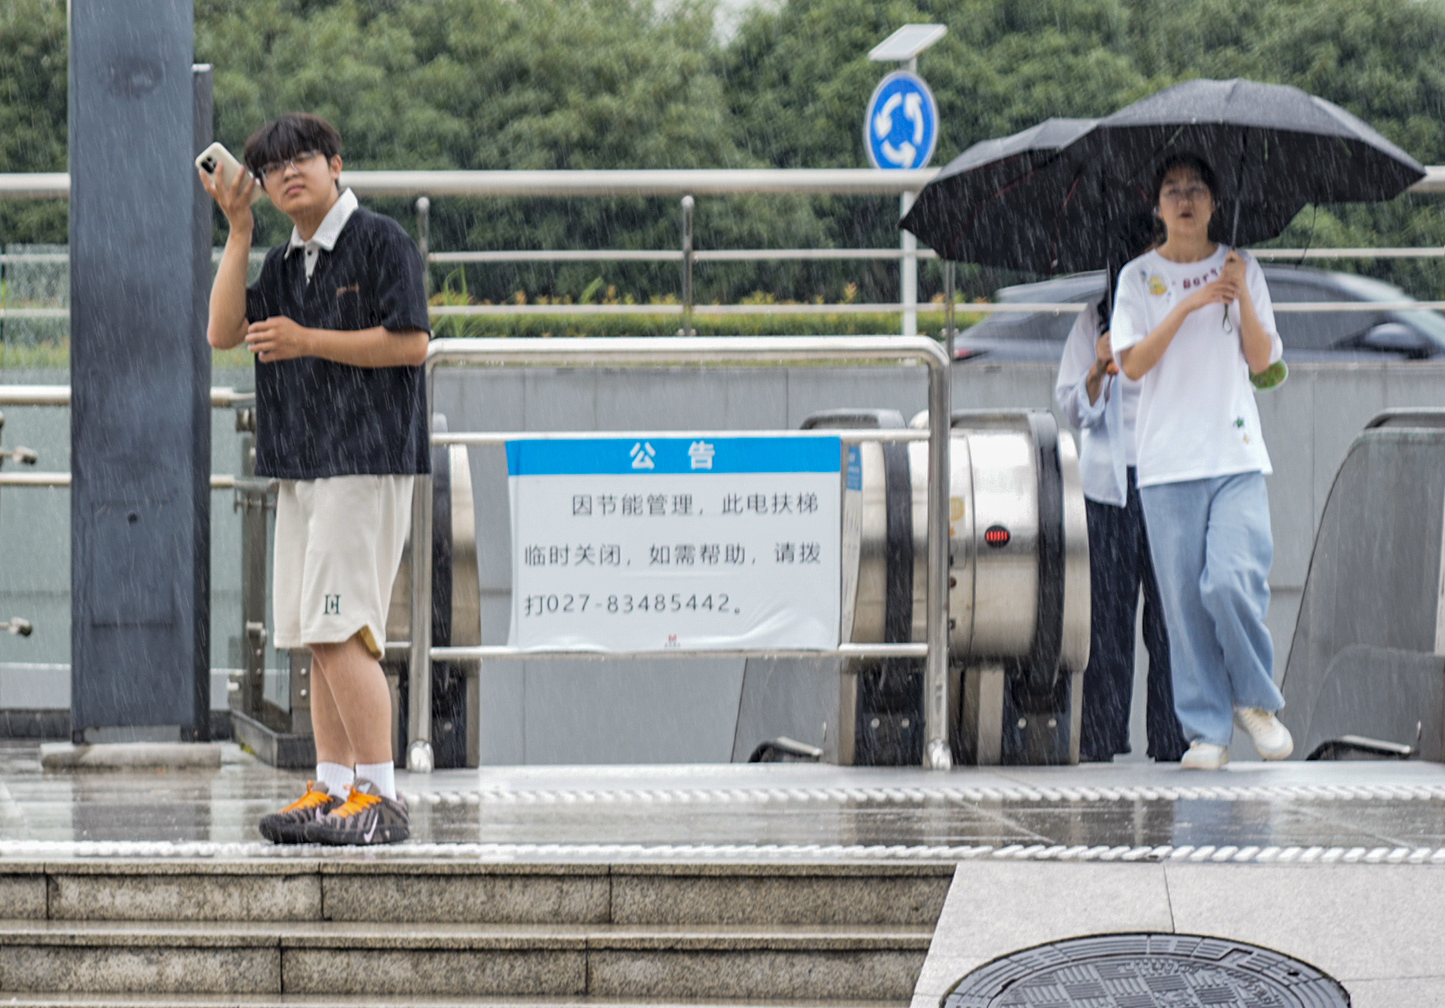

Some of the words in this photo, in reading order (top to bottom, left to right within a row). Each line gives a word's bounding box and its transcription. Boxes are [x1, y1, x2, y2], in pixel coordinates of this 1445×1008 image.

[629, 440, 716, 470] 公告
[571, 492, 819, 517] 因节能管理，此电扶梯
[524, 541, 822, 567] 临时关闭，如需帮助，请拨
[524, 593, 742, 617] 打027-83485442。
